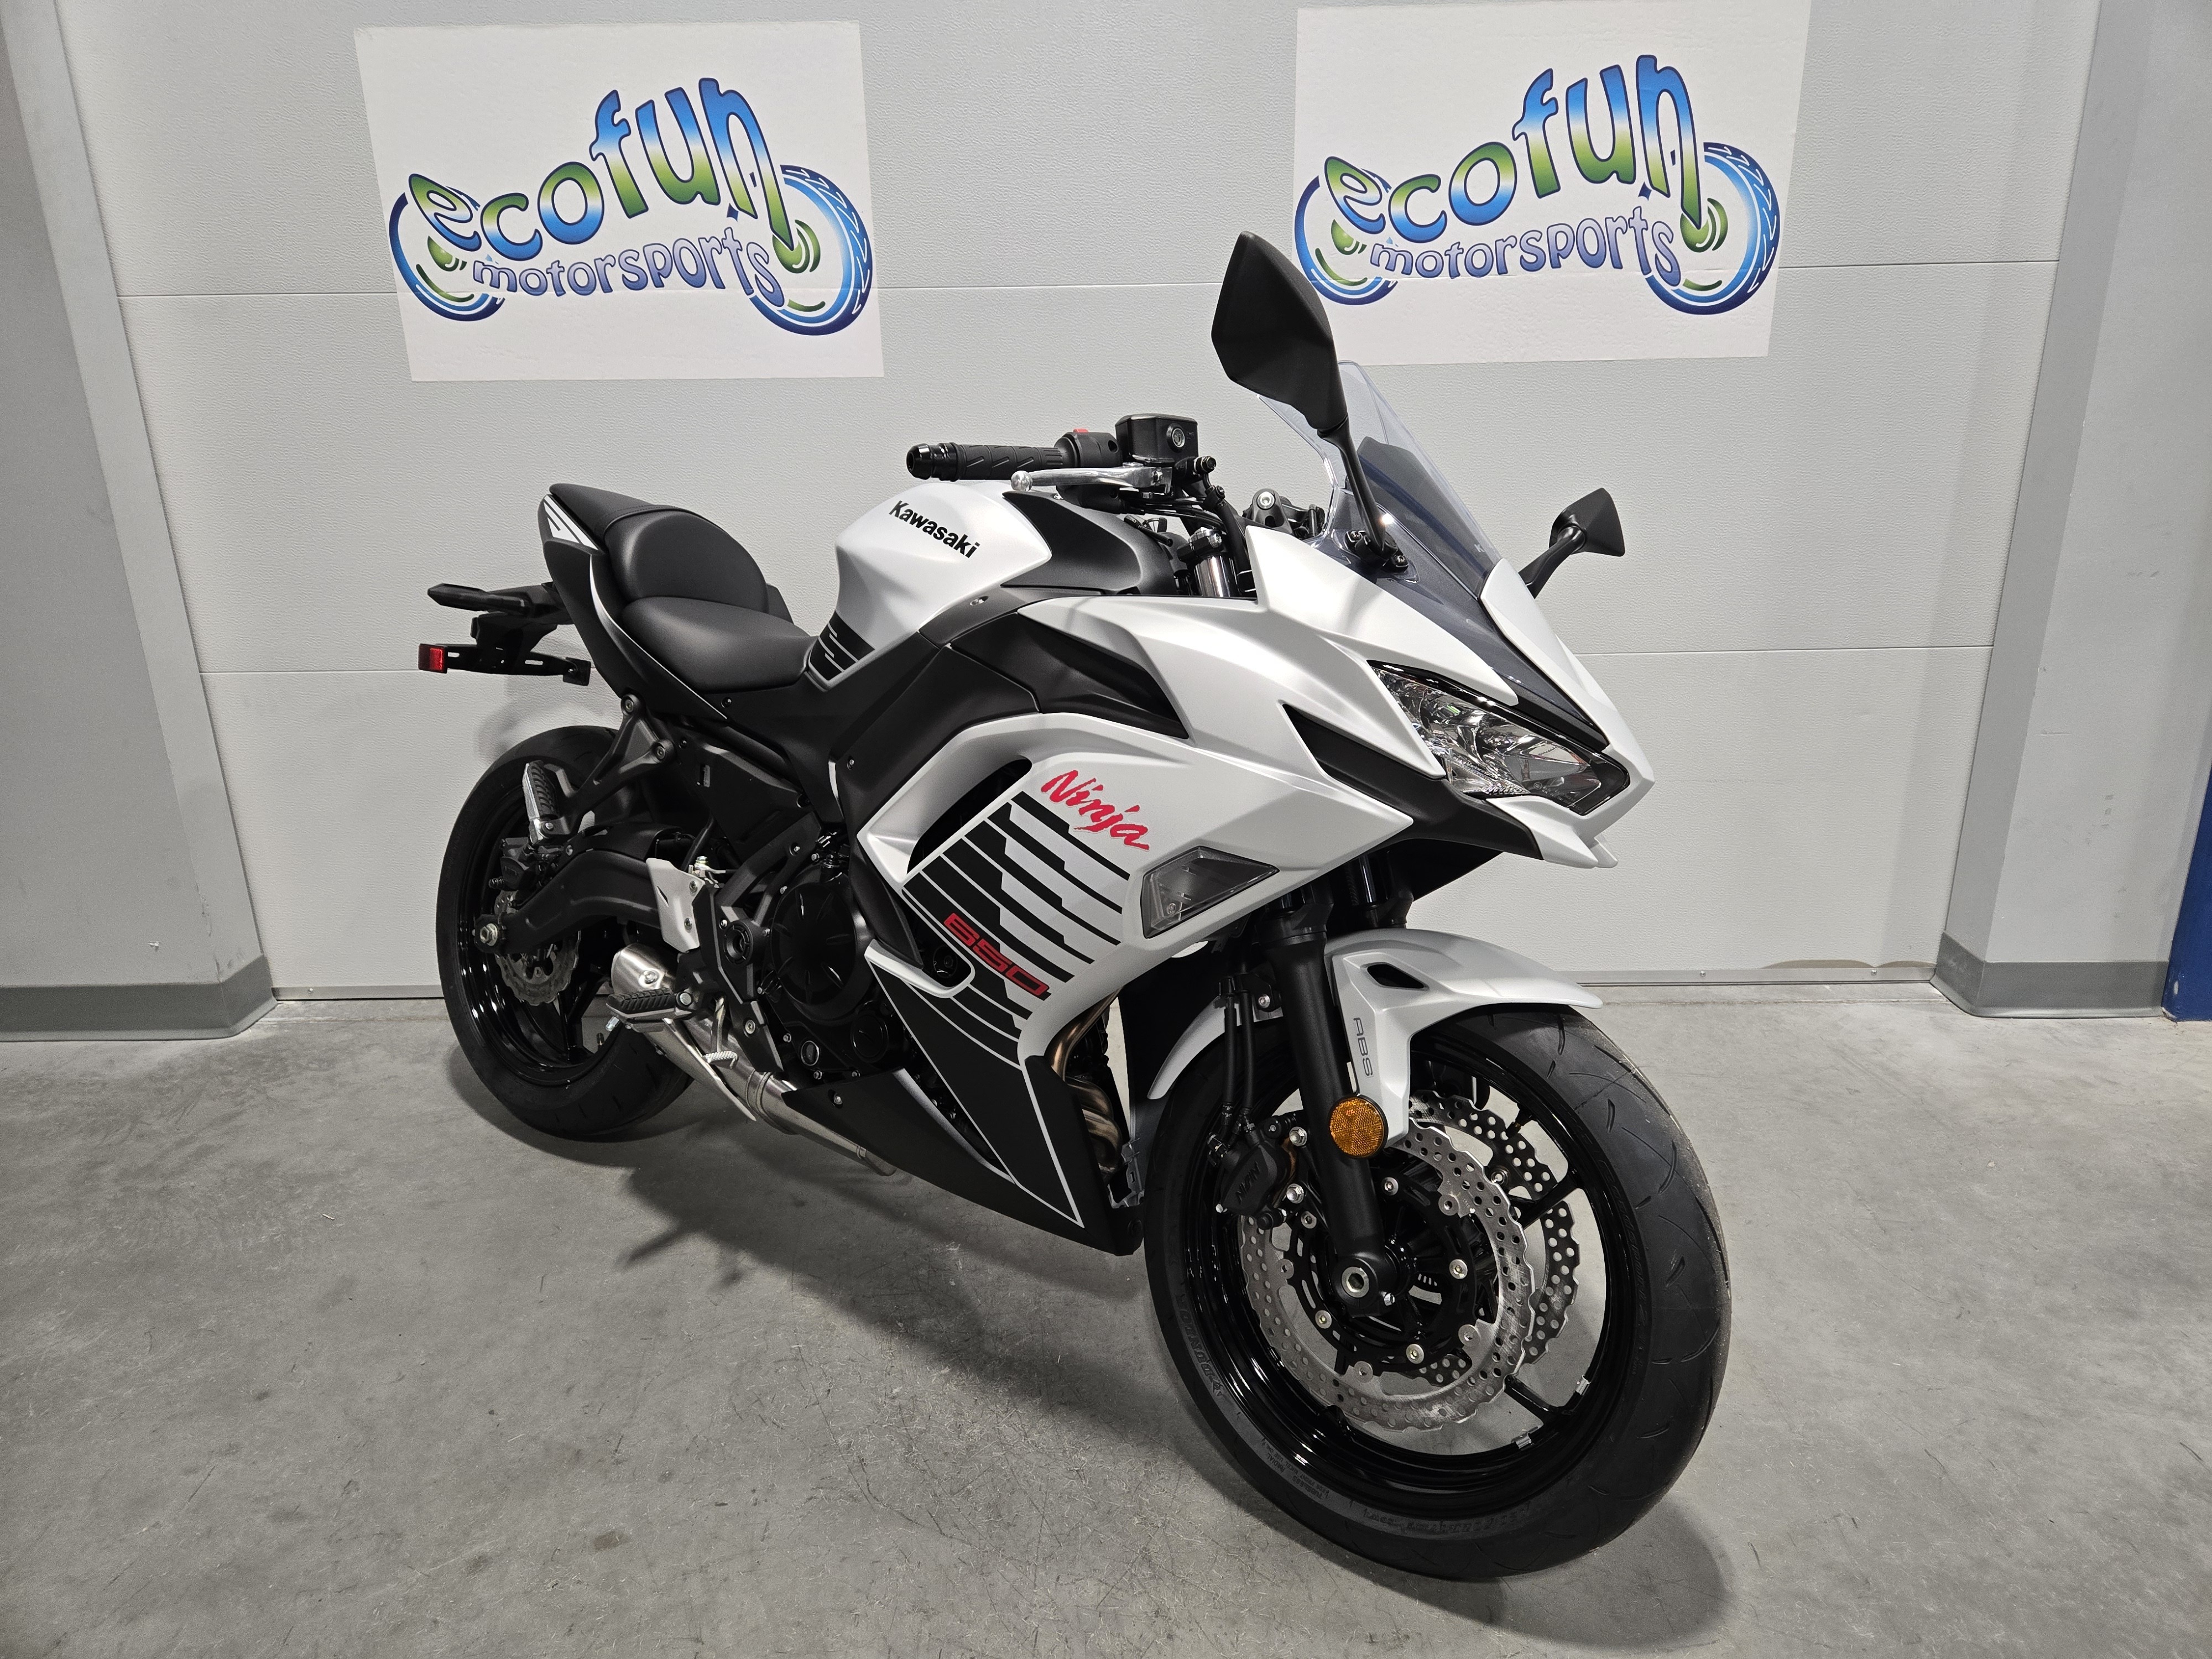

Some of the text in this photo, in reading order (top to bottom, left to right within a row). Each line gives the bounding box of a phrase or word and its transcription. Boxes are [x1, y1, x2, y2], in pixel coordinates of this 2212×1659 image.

[409, 78, 795, 261] ecofun
[1324, 54, 1702, 243] ecofun
[473, 227, 785, 307] motorsports
[1370, 206, 1681, 287] motorsports
[889, 500, 980, 559] Kawasaki
[1040, 769, 1150, 851] Ninja
[943, 913, 1050, 997] 650
[1353, 1017, 1374, 1077] ABS
[1267, 1453, 1286, 1472] RADIAL
